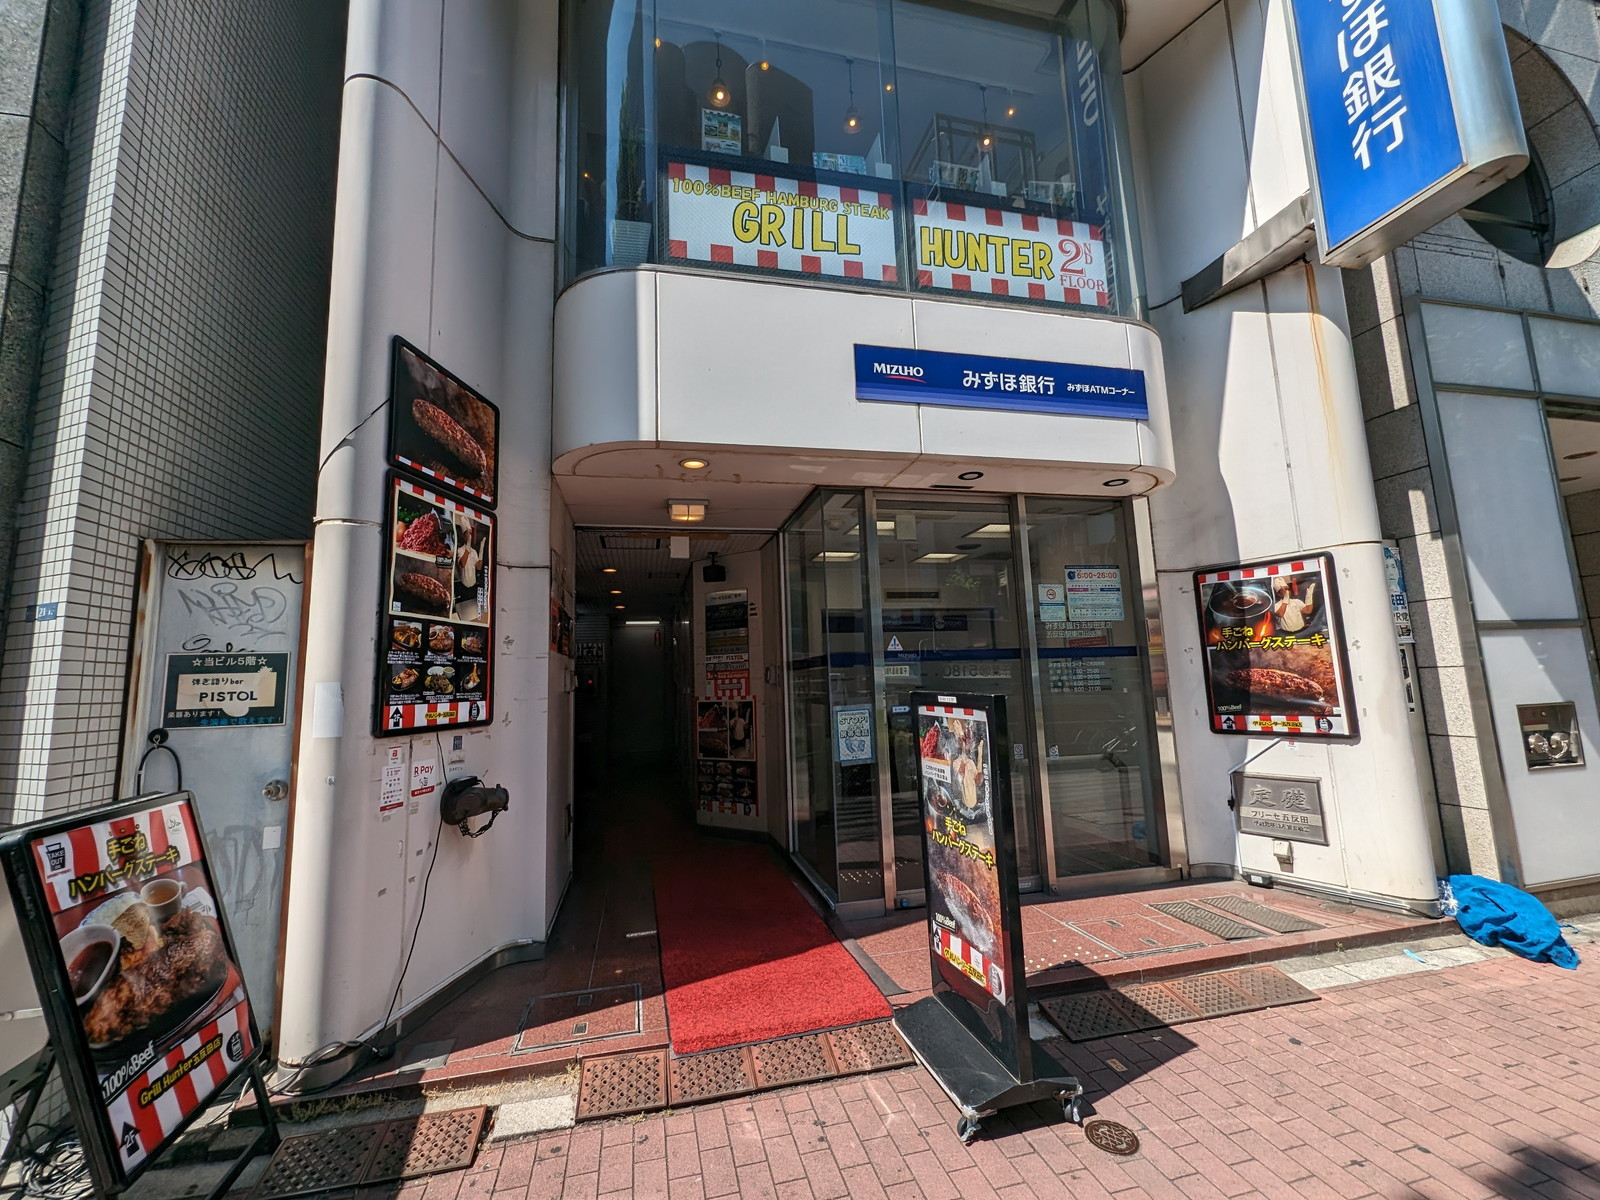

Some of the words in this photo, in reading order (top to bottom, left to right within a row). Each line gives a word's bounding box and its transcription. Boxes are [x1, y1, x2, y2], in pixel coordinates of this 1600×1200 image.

[672, 176, 761, 202] 100%BEEF
[766, 189, 839, 213] HAMBURG
[842, 201, 891, 220] STEAK
[732, 200, 861, 256] GRILL
[919, 225, 1056, 281] HUNTER
[1059, 274, 1106, 293] FLOOR
[873, 362, 924, 378] MIZUHO
[963, 369, 1056, 396] みずほ銀行
[1066, 382, 1136, 396] みずほATMコーナー
[1221, 626, 1254, 638] 手ごね
[1215, 633, 1328, 653] ハンバーグステーキ
[199, 690, 259, 703] PISTOL
[420, 765, 434, 775] Pay
[945, 816, 967, 836] 手ごね
[47, 849, 66, 859] TAKE
[108, 834, 147, 860] 手ごね
[51, 857, 64, 866] OUT
[69, 846, 179, 898] ハンバーグステーキ
[102, 1040, 156, 1099] 100%Beef
[140, 1082, 163, 1106] Grill
[162, 1058, 194, 1089] Hunter
[124, 1130, 137, 1149] 2F
